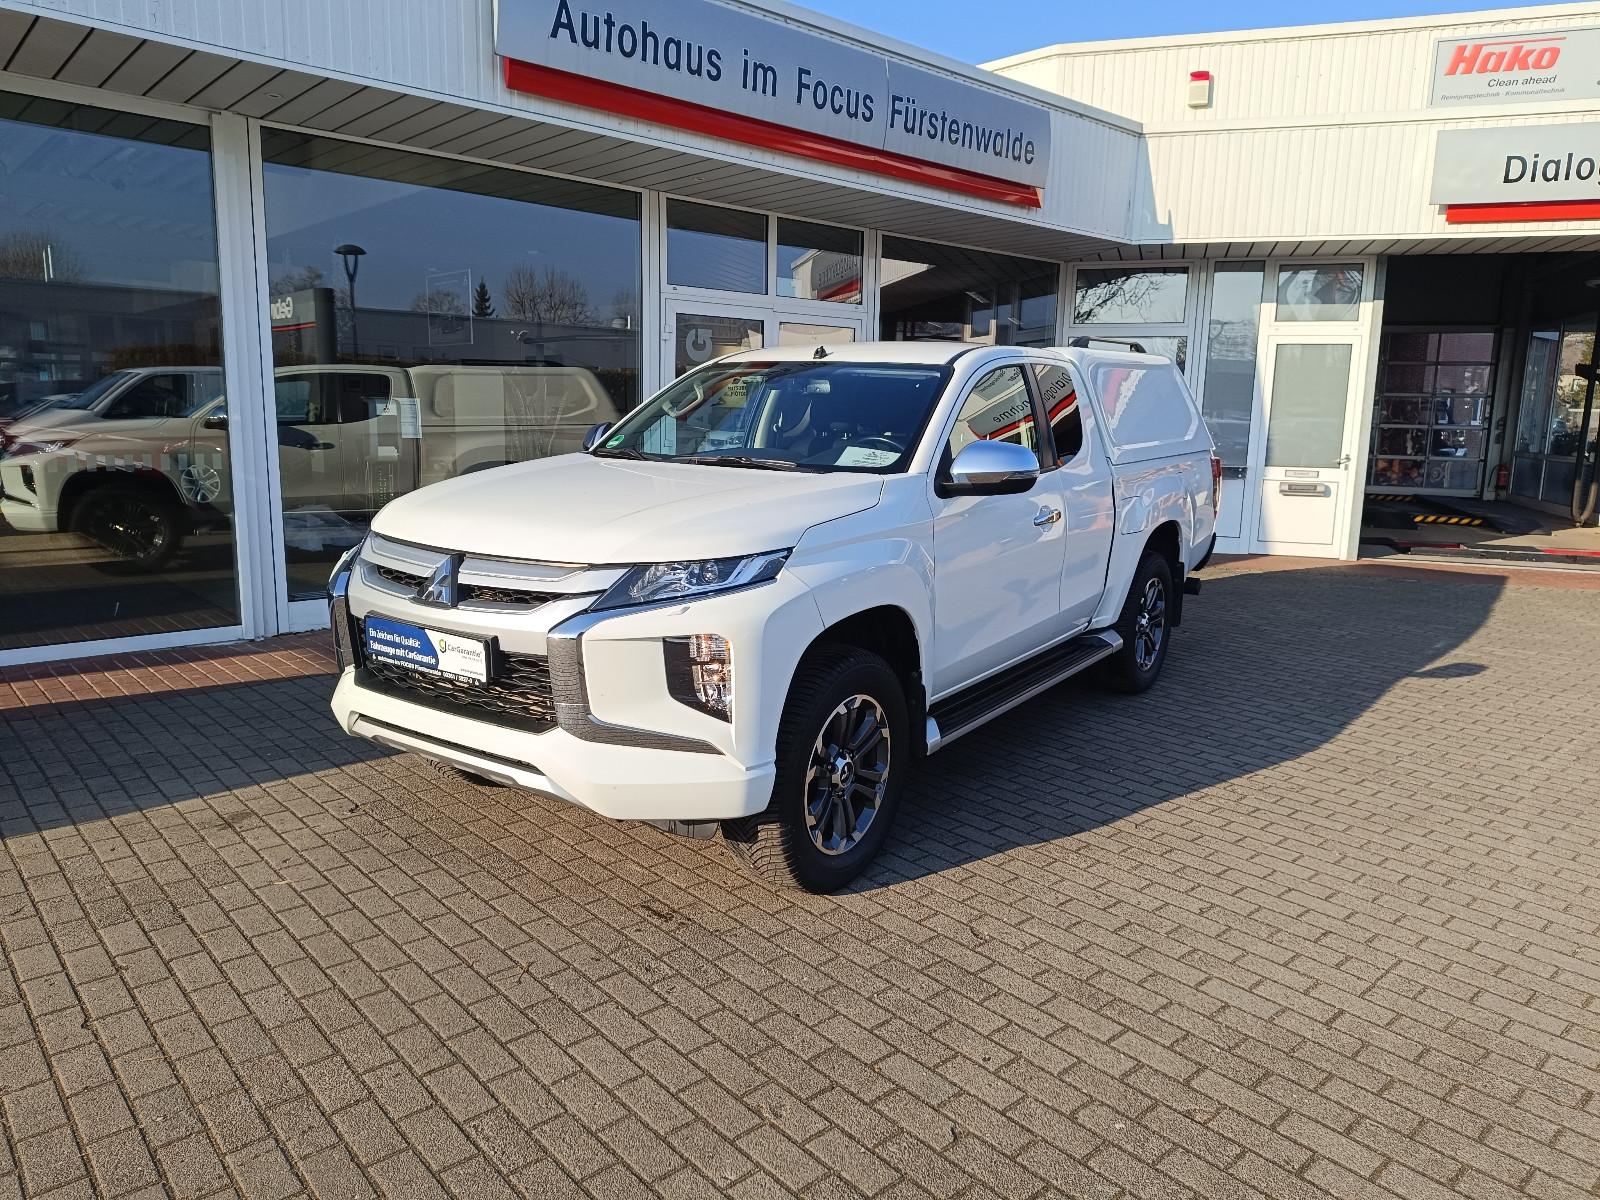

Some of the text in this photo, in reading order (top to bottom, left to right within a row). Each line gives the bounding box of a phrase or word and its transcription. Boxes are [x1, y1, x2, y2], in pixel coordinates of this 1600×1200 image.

[1444, 37, 1567, 76] Hako
[550, 0, 1036, 165] Autohaus im Focus Fürstenwalde
[1487, 75, 1558, 88] Clean ahead
[1503, 152, 1600, 186] Dialo
